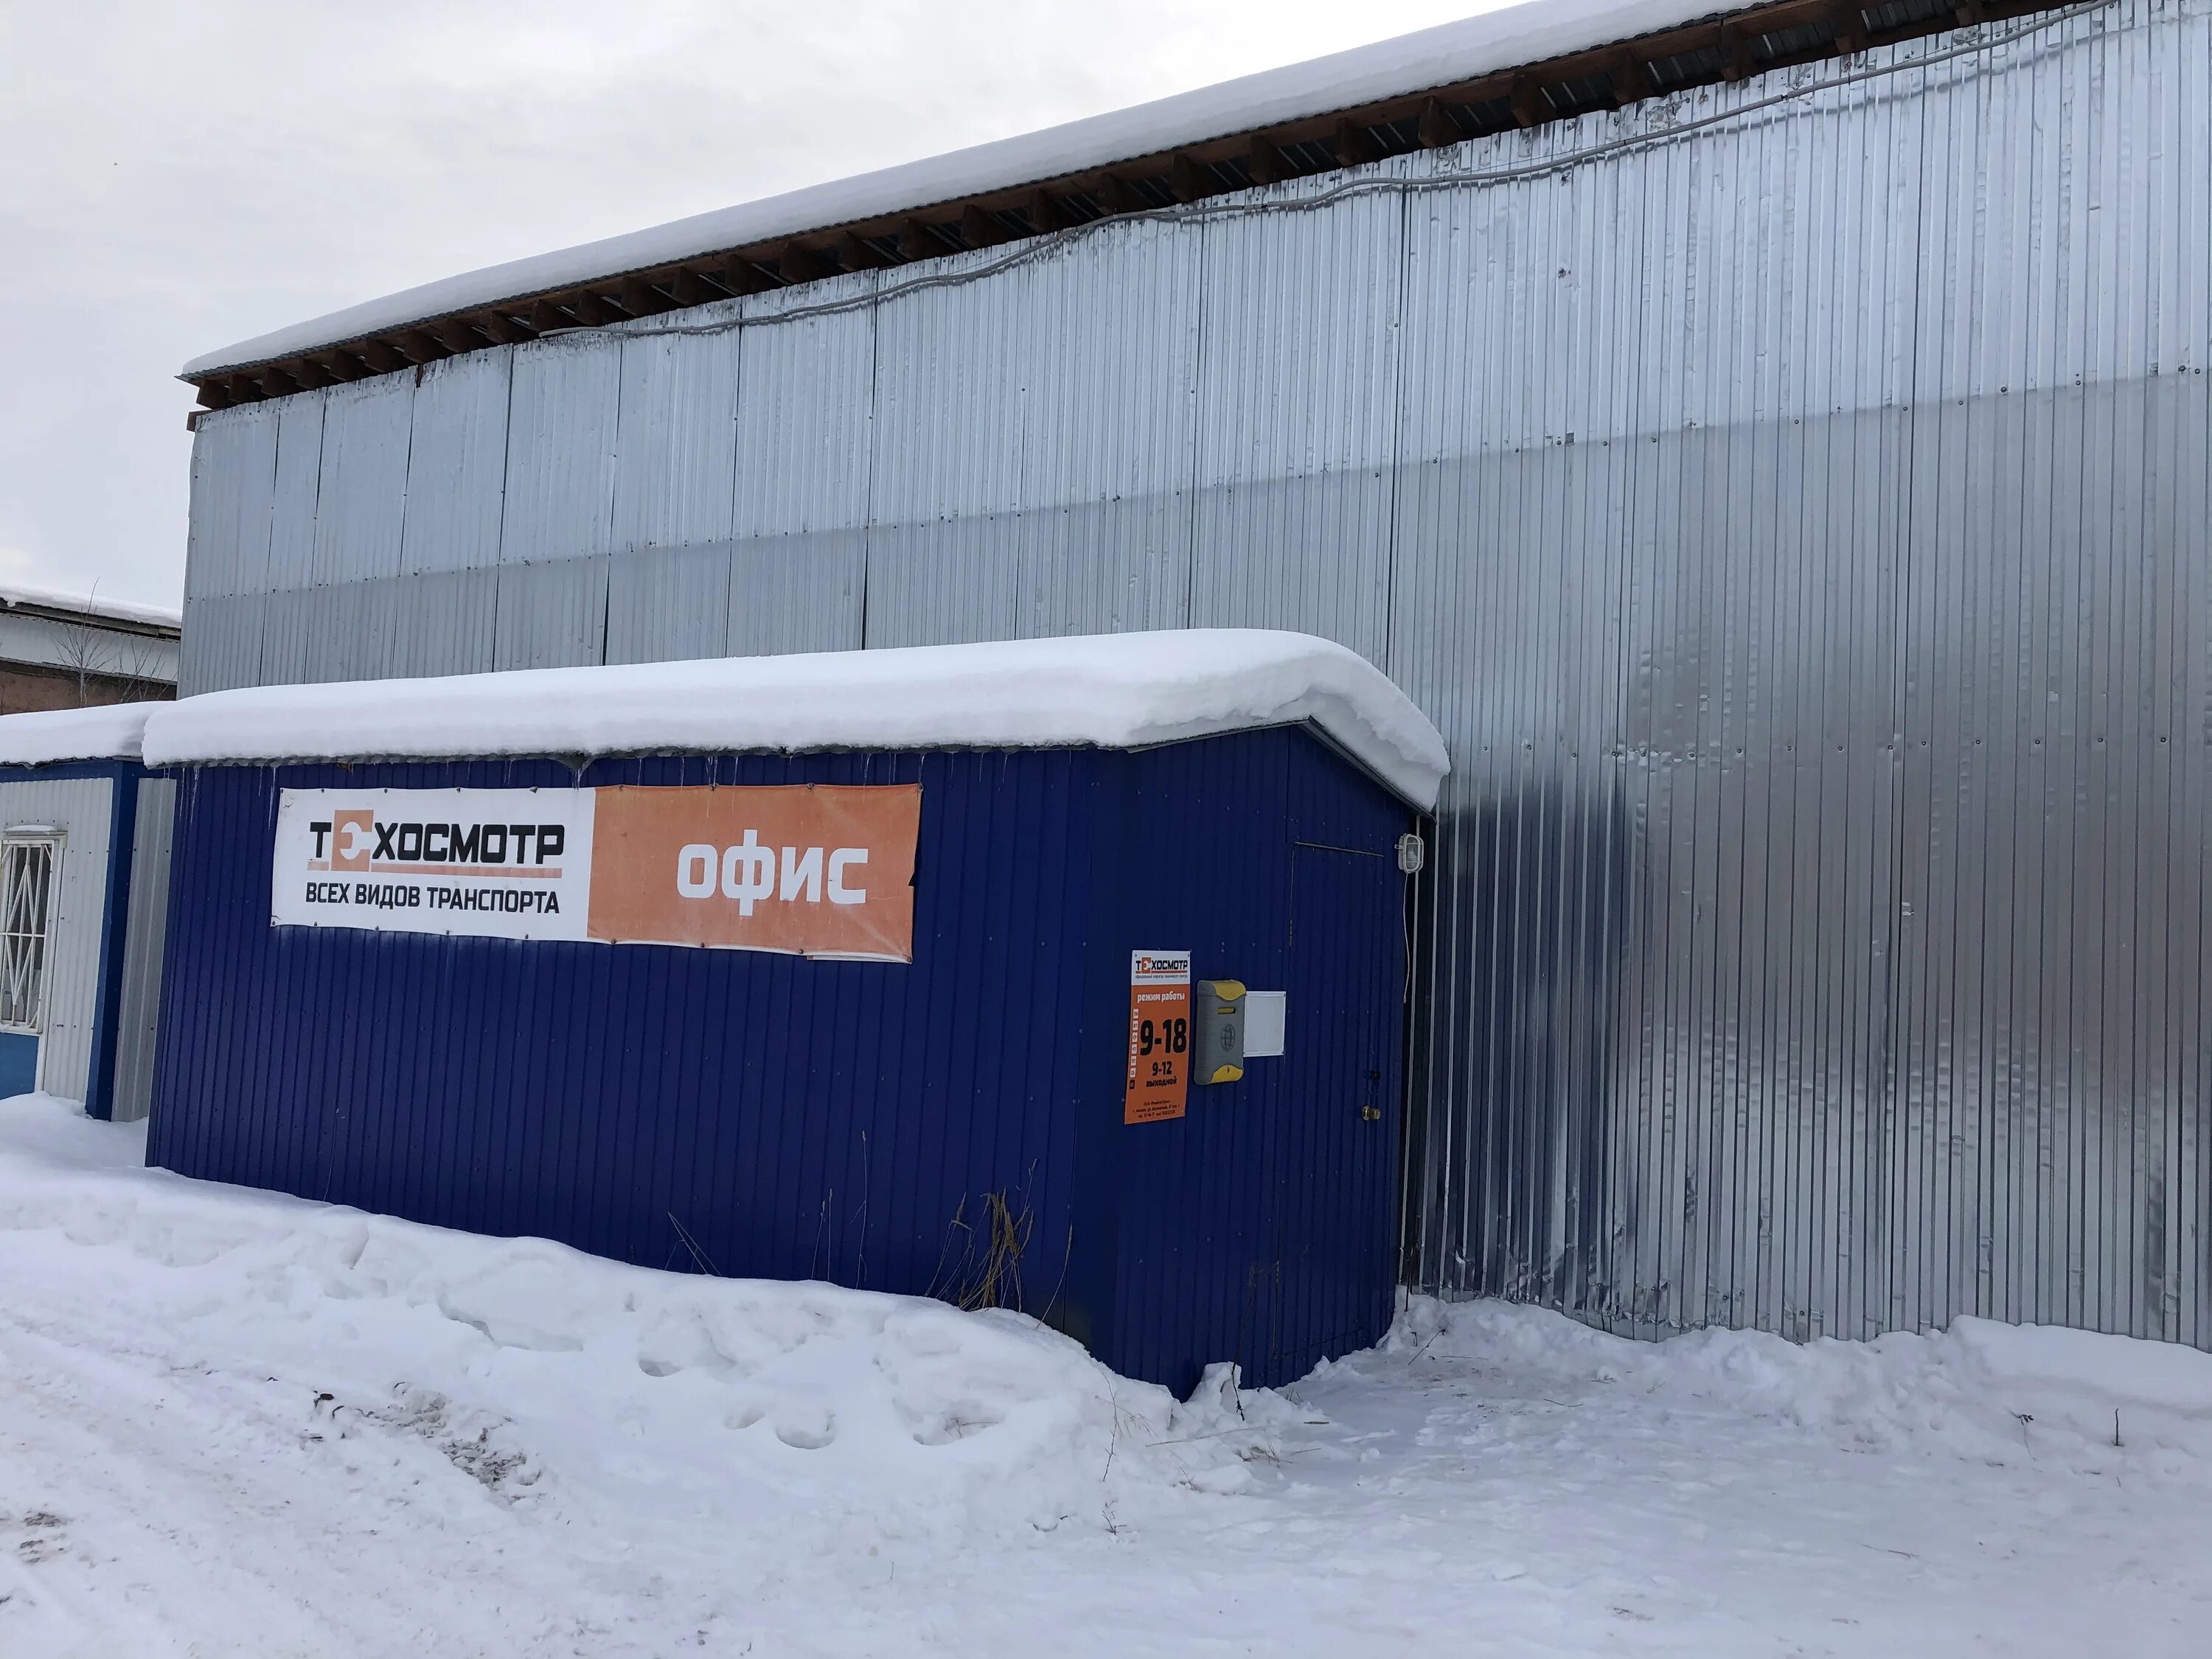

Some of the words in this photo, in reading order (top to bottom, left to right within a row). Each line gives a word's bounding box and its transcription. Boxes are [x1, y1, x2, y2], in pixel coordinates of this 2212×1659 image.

[305, 883, 351, 905] ВСЕХ
[355, 884, 420, 910] ВИДОВ
[426, 887, 560, 914] ТРАНСПОРТА
[1137, 993, 1161, 1003] режим
[1161, 990, 1185, 1002] работы
[1140, 1018, 1187, 1056] 9-18
[1152, 1061, 1172, 1076] 9-12
[1146, 1076, 1178, 1088] выходной
